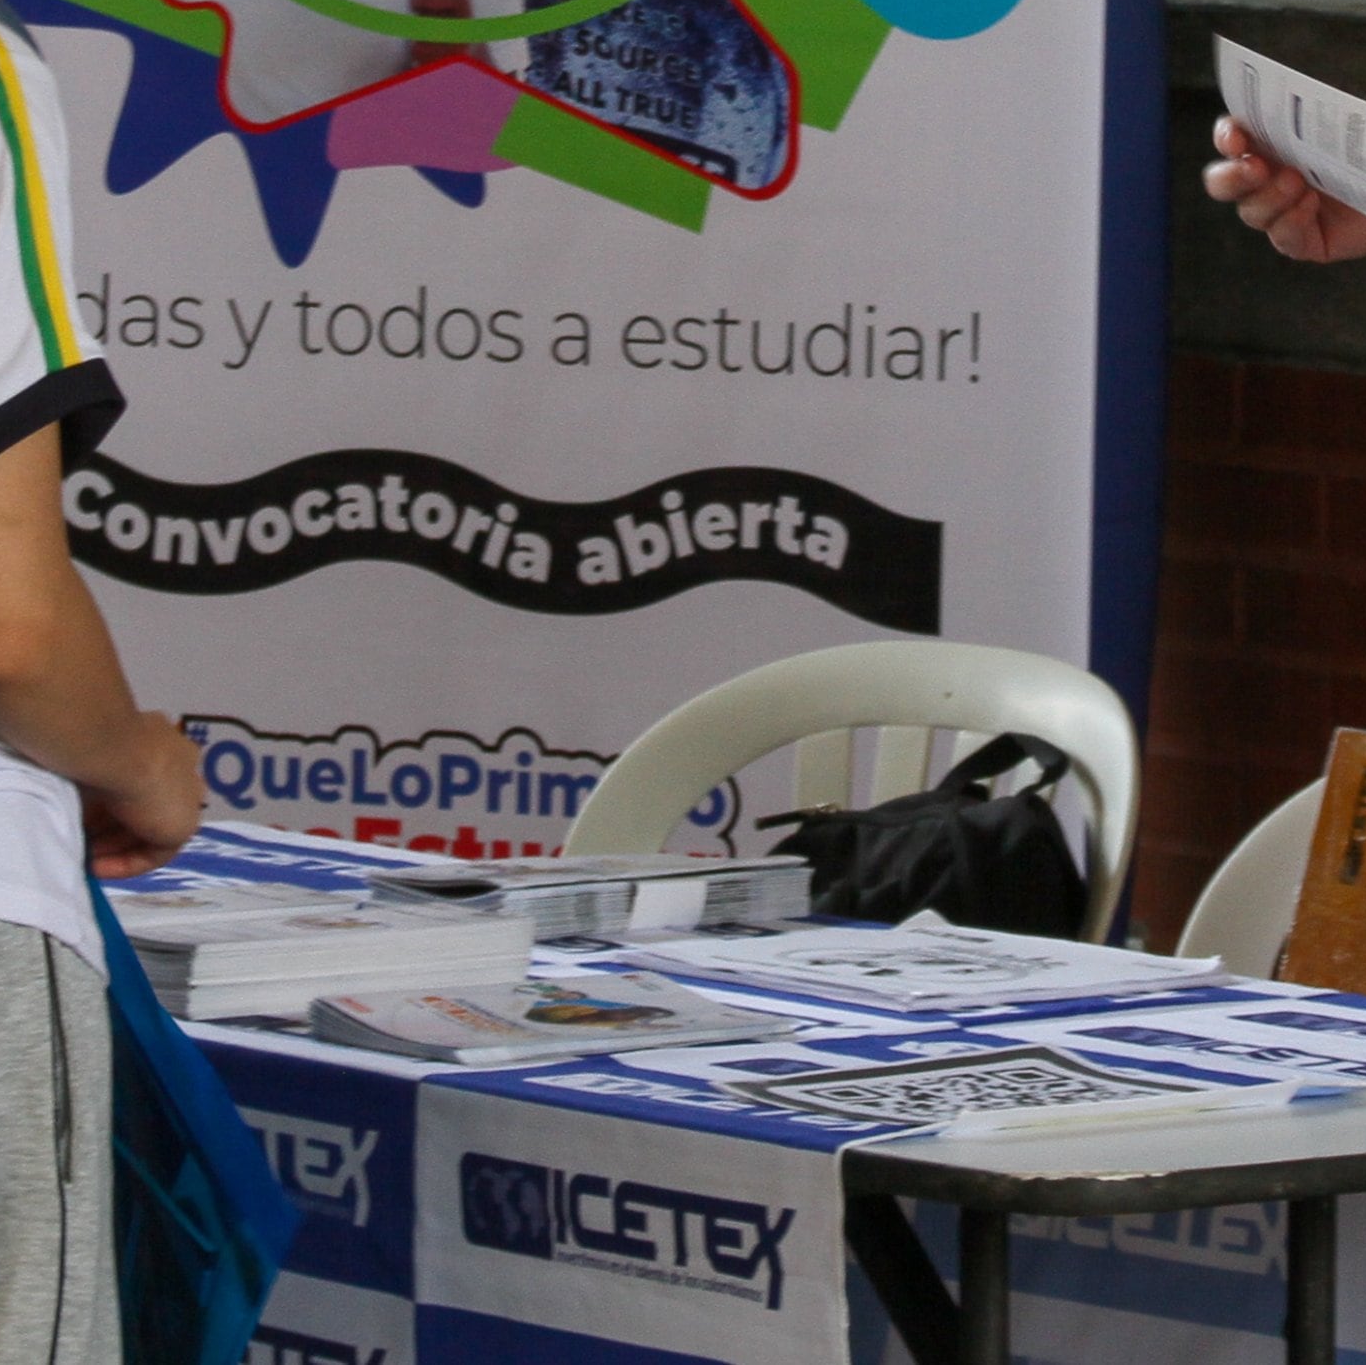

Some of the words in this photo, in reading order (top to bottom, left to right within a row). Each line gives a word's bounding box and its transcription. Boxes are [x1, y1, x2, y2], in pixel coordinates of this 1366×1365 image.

[615, 85, 702, 130] TRUE
[224, 297, 272, 370] y
[293, 285, 526, 364] todos
[550, 310, 593, 367] a
[620, 301, 984, 384] estudiar!
[62, 468, 553, 584] Convocatoria
[575, 490, 851, 587] abierta
[552, 1167, 798, 1312] ICETEX
